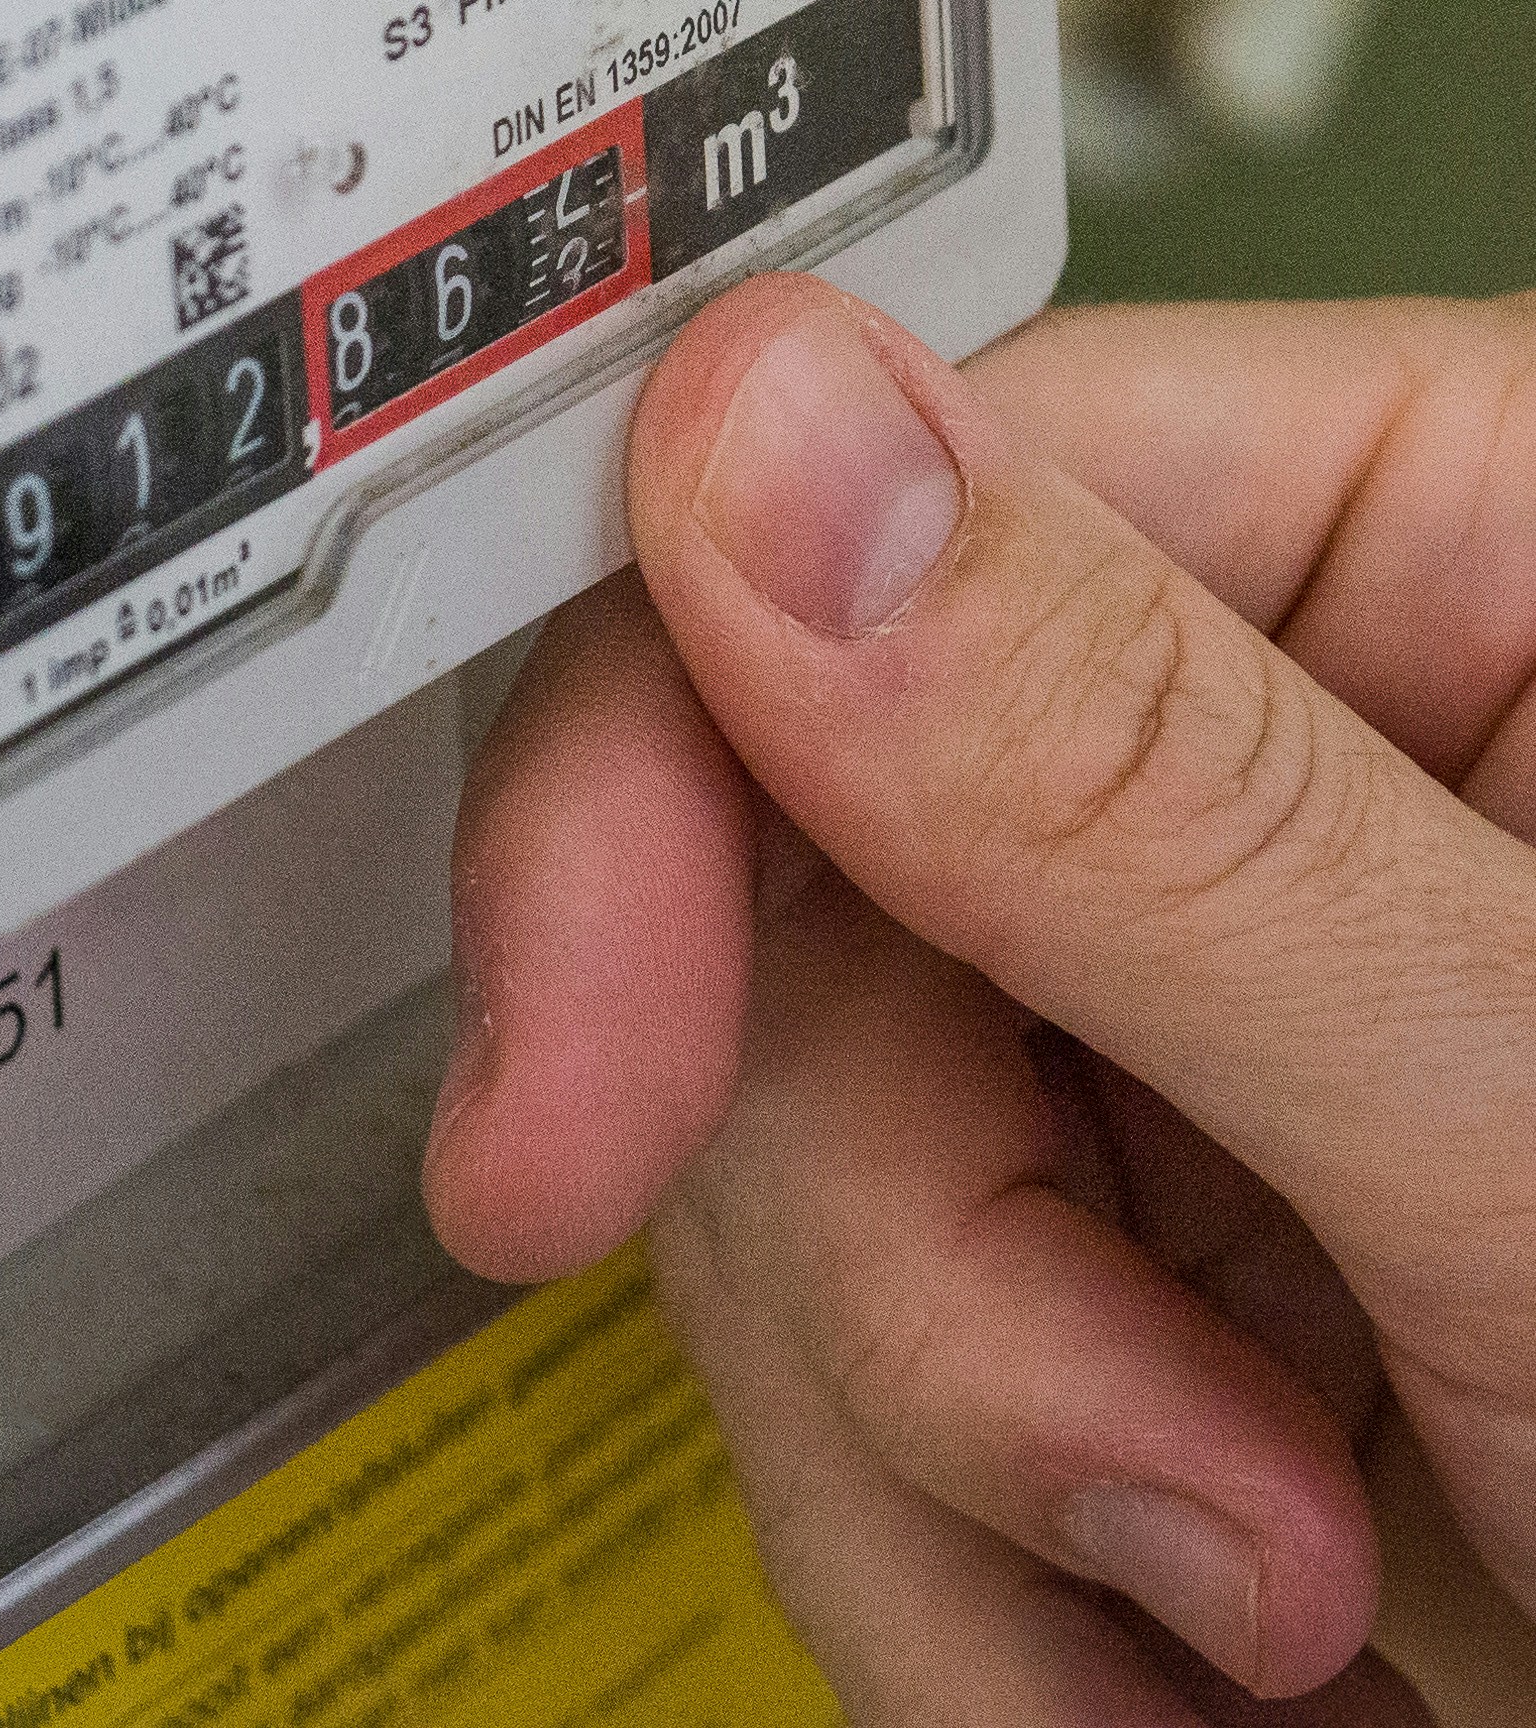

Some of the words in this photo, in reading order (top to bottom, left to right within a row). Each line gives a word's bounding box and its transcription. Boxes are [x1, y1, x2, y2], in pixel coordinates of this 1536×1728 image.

[382, 4, 434, 62] S3
[493, 97, 545, 158] DIN
[555, 72, 597, 124] EN
